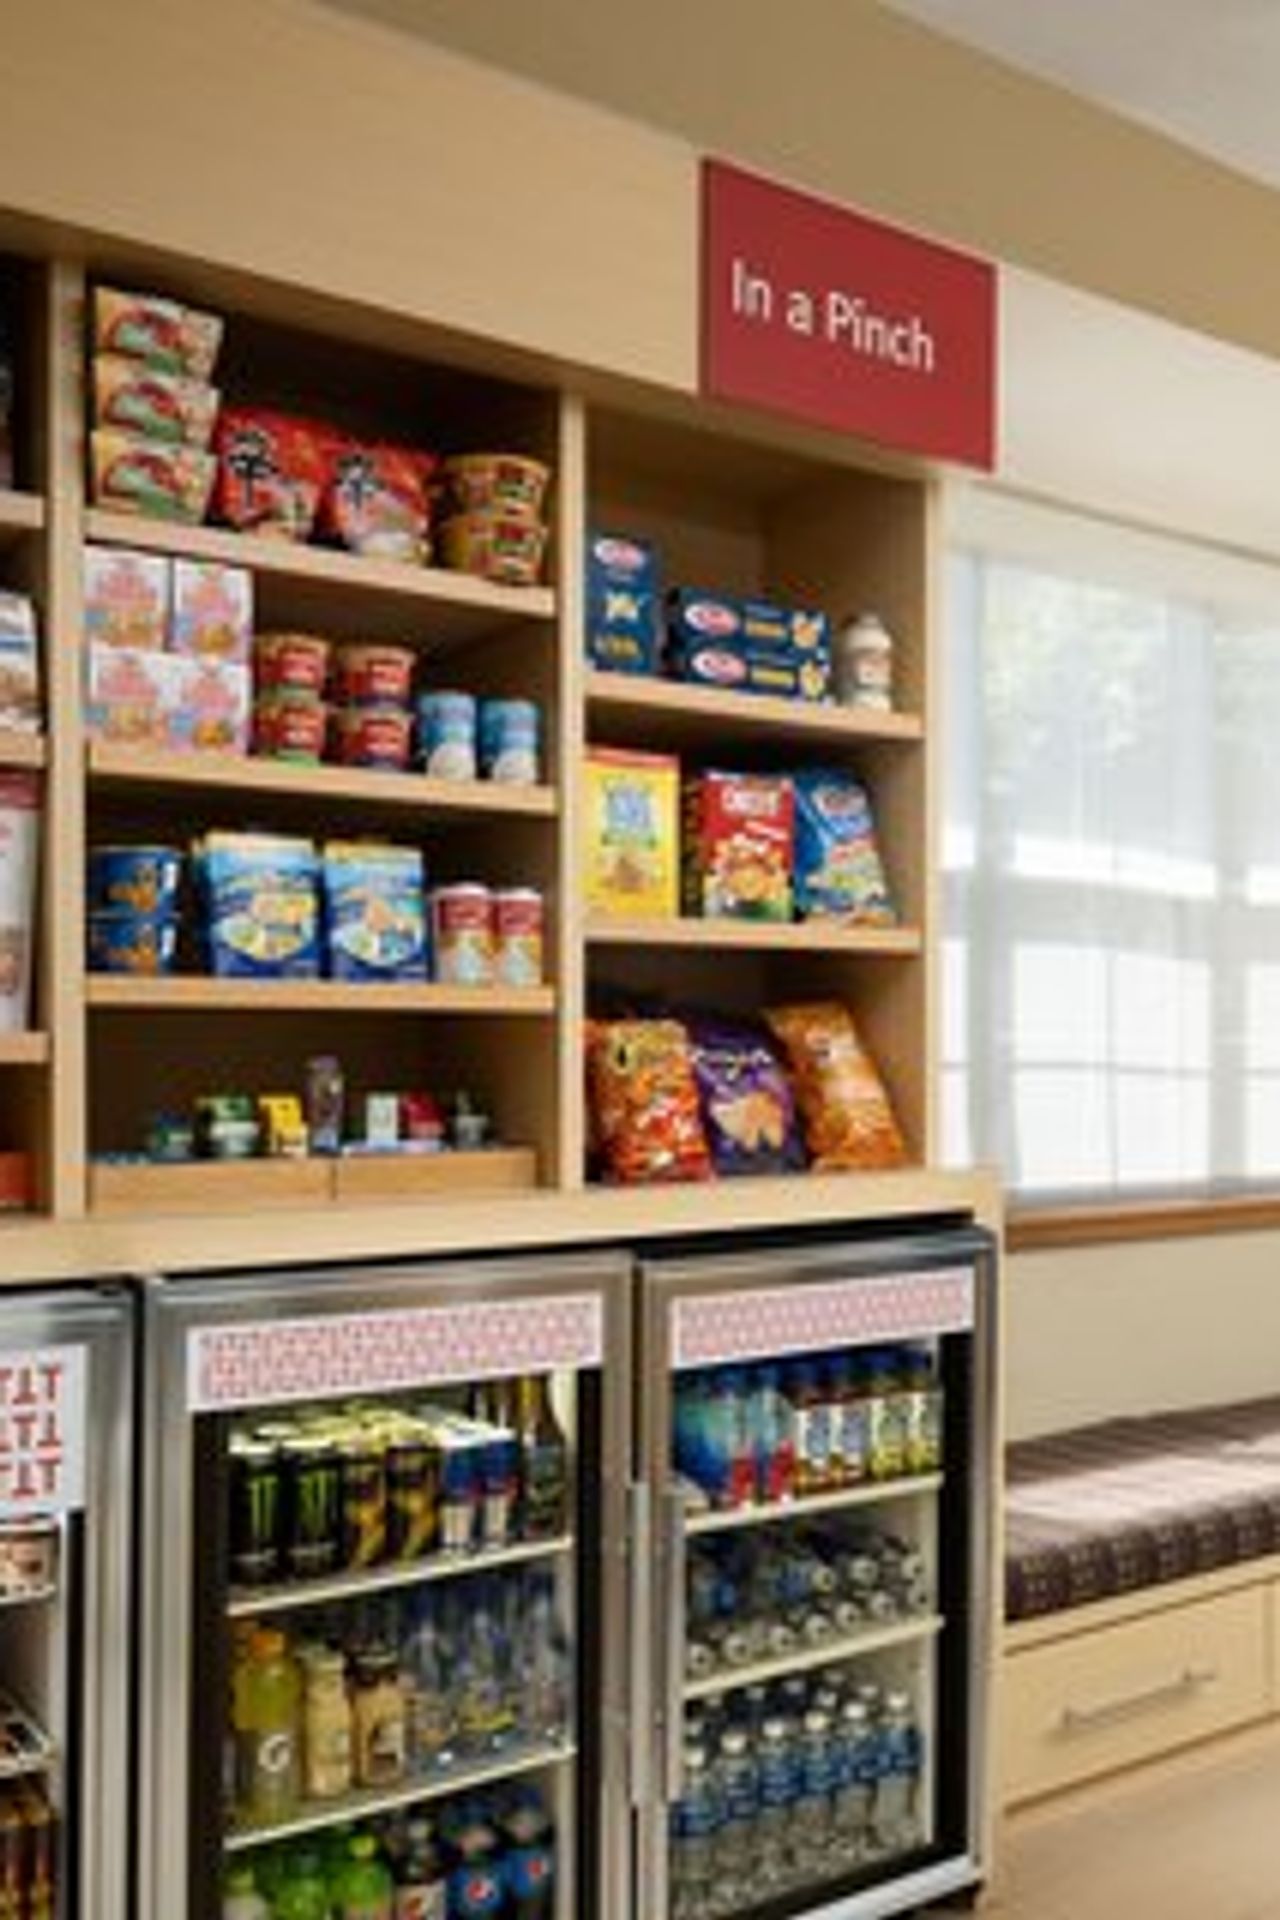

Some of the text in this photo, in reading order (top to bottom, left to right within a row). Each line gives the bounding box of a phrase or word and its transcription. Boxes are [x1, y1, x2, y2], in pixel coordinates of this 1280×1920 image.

[732, 258, 935, 373] In a Pinch
